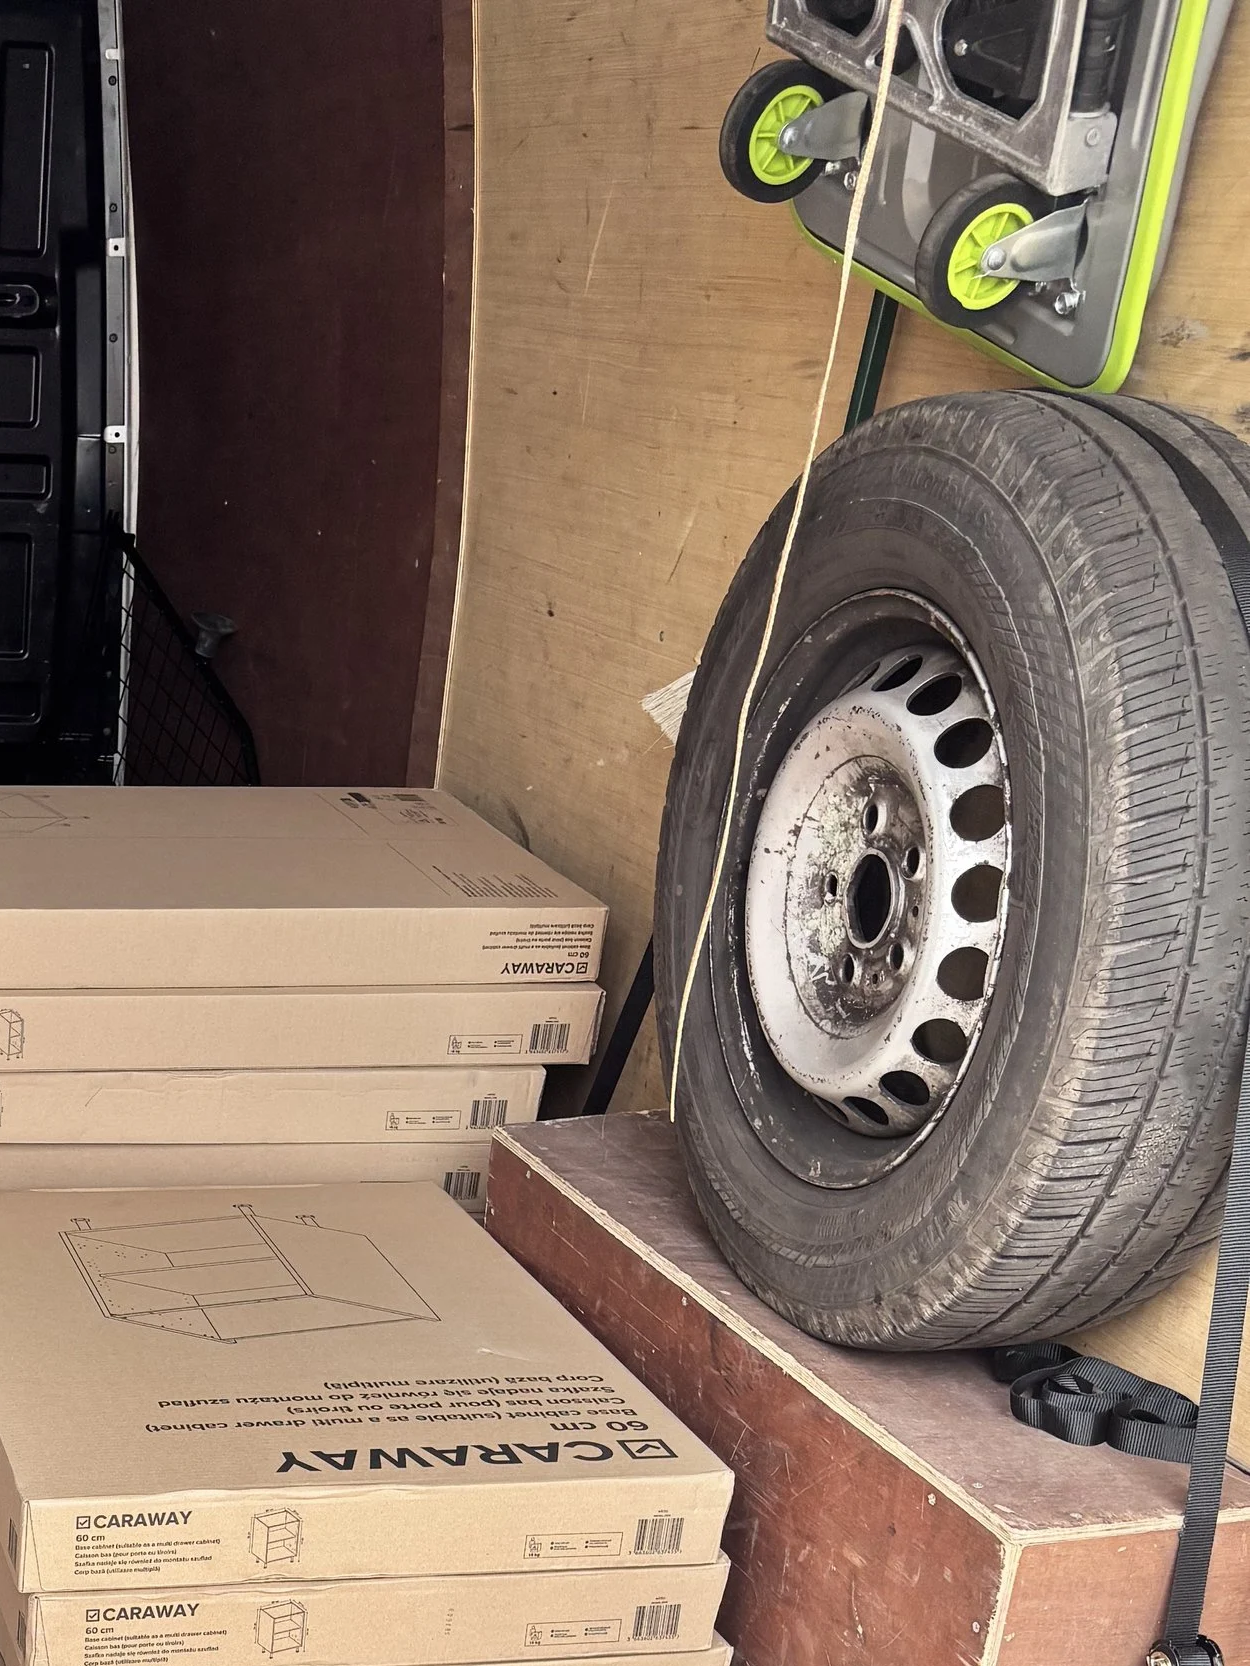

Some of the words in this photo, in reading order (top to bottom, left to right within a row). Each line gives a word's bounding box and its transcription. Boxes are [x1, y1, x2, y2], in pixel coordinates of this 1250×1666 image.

[501, 962, 575, 974] CARAWAY
[416, 1376, 500, 1386] (utilizare
[557, 1375, 604, 1383] Corp
[479, 1386, 544, 1396] nadaje
[548, 1386, 616, 1395] Szafka
[329, 1393, 353, 1401] do
[546, 1397, 626, 1405] Caisson
[158, 1397, 231, 1409] szuflad
[389, 1400, 442, 1411] porte
[449, 1399, 501, 1410] (pour
[507, 1398, 543, 1407] bas
[287, 1404, 354, 1415] tiroirs)
[508, 1408, 581, 1418] cabinet
[587, 1408, 638, 1417] Base
[312, 1416, 362, 1426] multi
[416, 1411, 502, 1422] (suitable
[145, 1422, 228, 1433] cabinet)
[235, 1418, 306, 1428] drawer
[550, 1422, 597, 1431] cm
[606, 1420, 649, 1431] 60
[276, 1440, 614, 1473] CARAWAY
[93, 1510, 193, 1529] CARAWAY
[76, 1534, 89, 1543] 60
[102, 1603, 200, 1622] CARAWAY
[85, 1627, 98, 1635] 60
